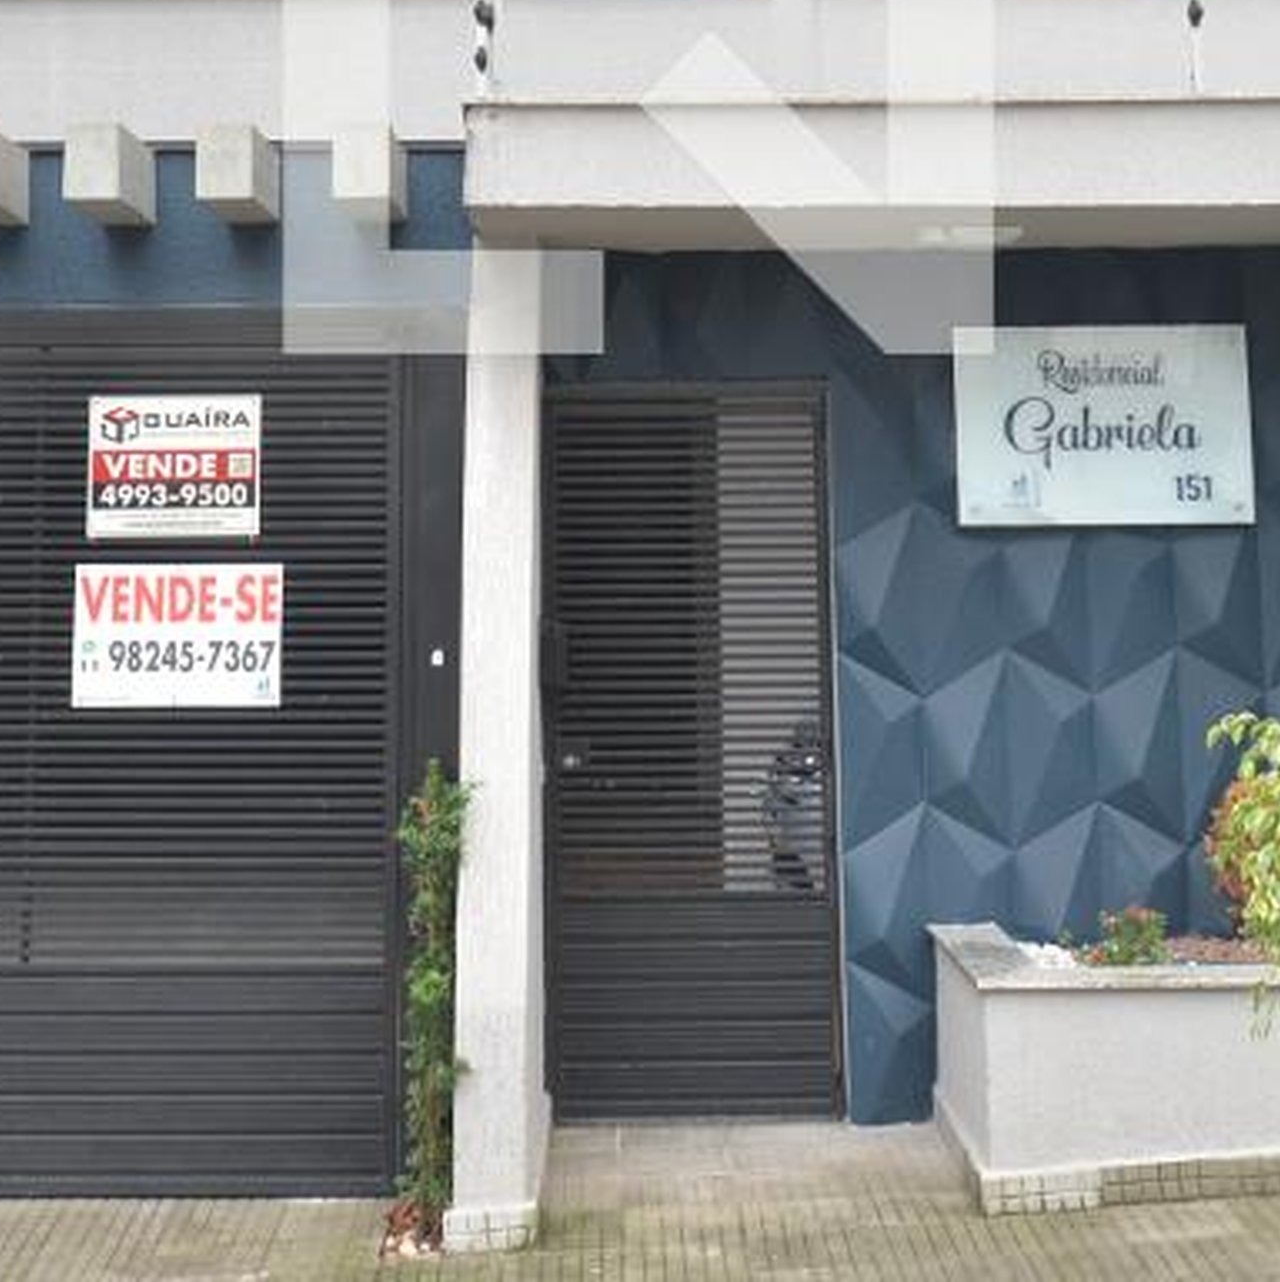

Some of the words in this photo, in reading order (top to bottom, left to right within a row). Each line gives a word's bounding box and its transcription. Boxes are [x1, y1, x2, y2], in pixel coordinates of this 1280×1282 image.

[1004, 396, 1201, 470] Gabriela
[102, 453, 217, 479] VENDE
[99, 483, 248, 506] 4993-9500
[1176, 475, 1212, 502] 151
[80, 575, 280, 623] VENDE-SE
[108, 640, 277, 673] 98245-7367
